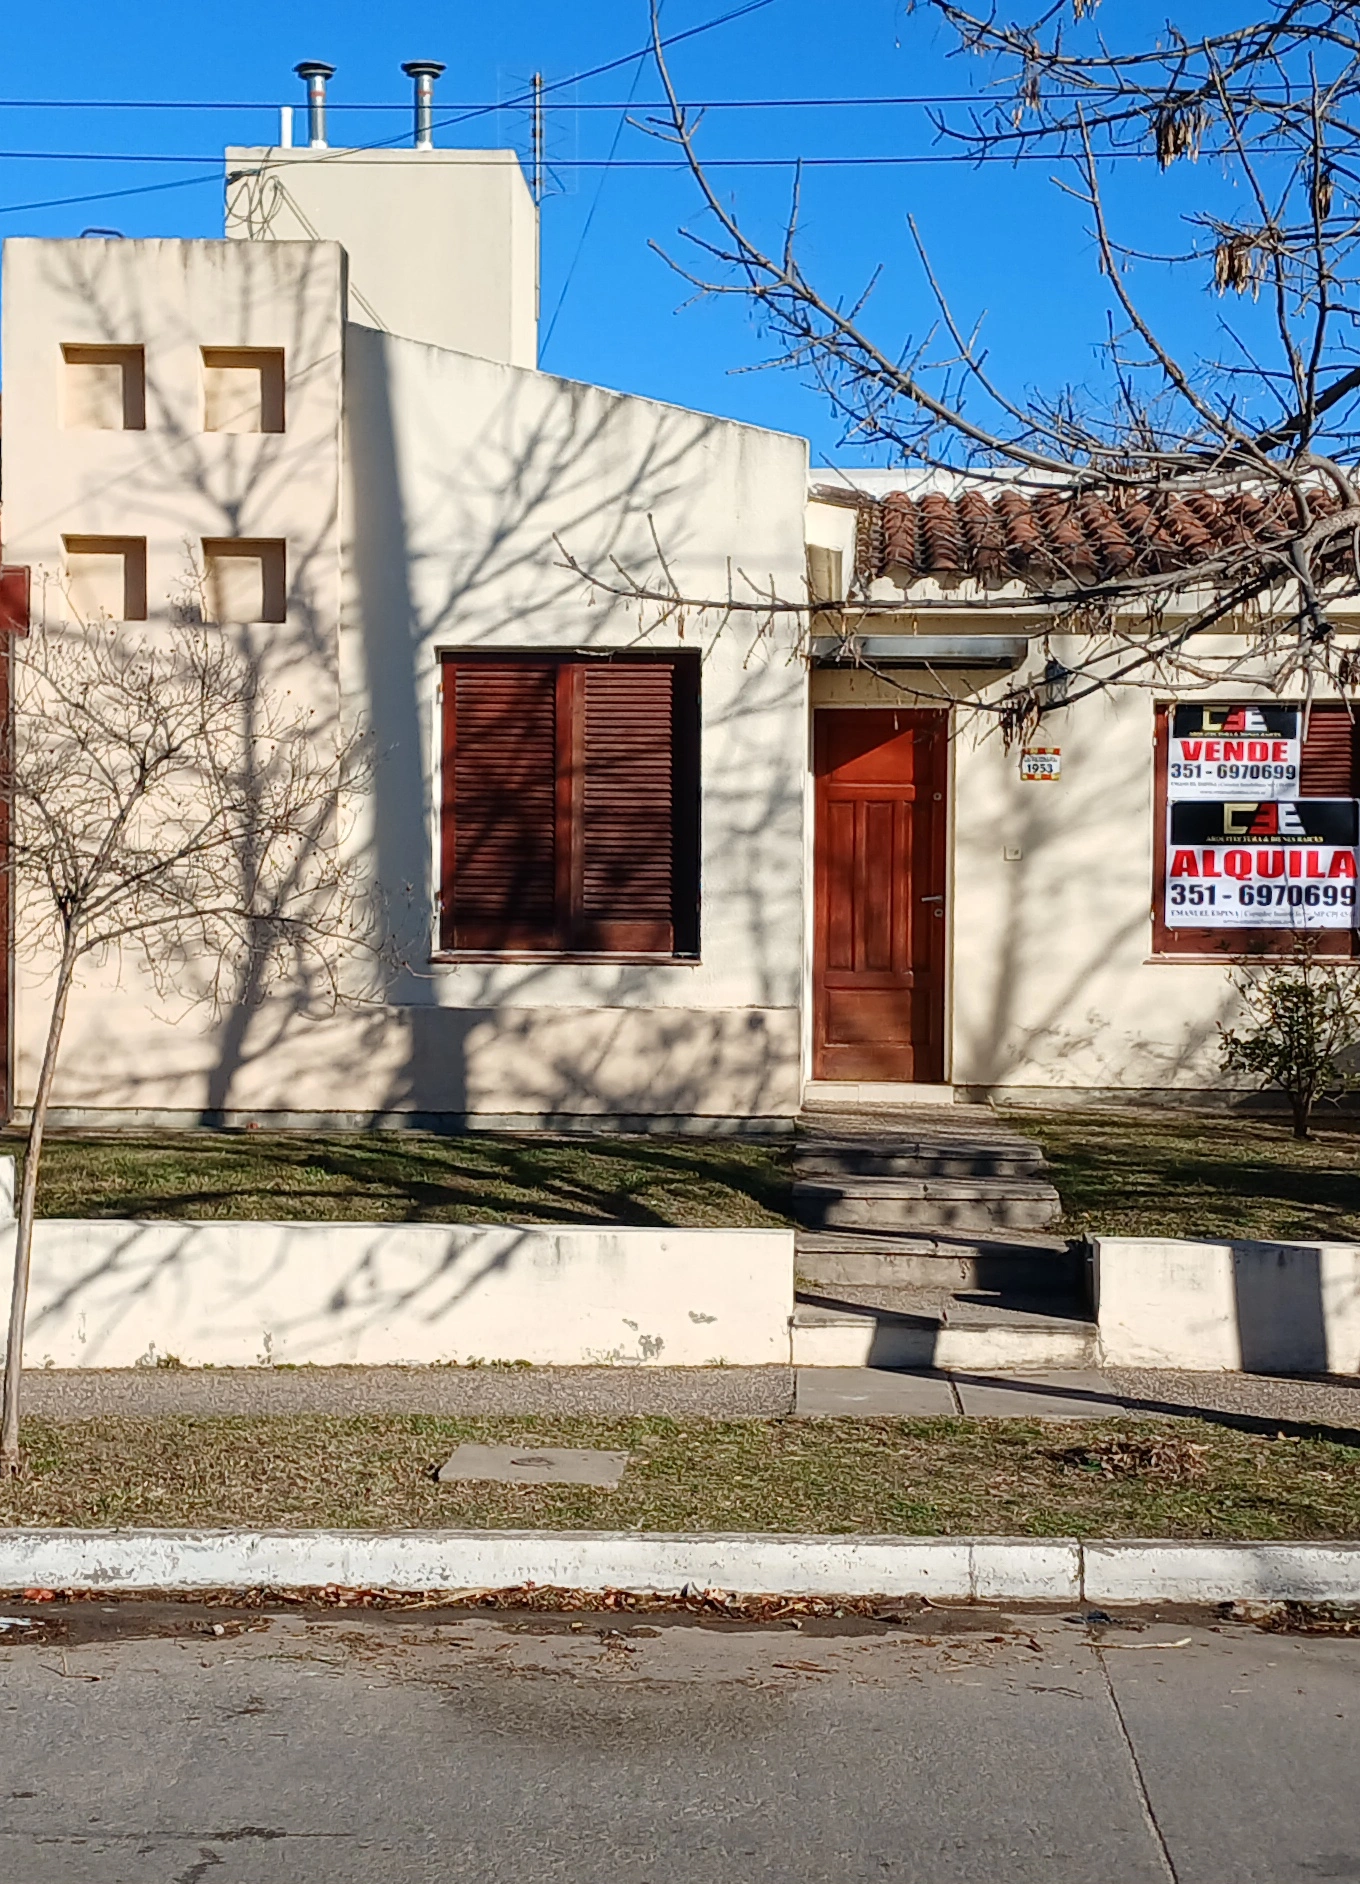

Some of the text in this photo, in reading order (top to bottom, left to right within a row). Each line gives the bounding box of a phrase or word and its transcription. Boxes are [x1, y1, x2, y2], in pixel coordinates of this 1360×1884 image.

[1180, 740, 1289, 762] VENDE
[1171, 763, 1202, 779] 351
[1217, 764, 1296, 780] 6970699
[1170, 850, 1358, 880] ALQUILA
[1171, 884, 1216, 905] 351
[1239, 884, 1356, 906] 6970699
